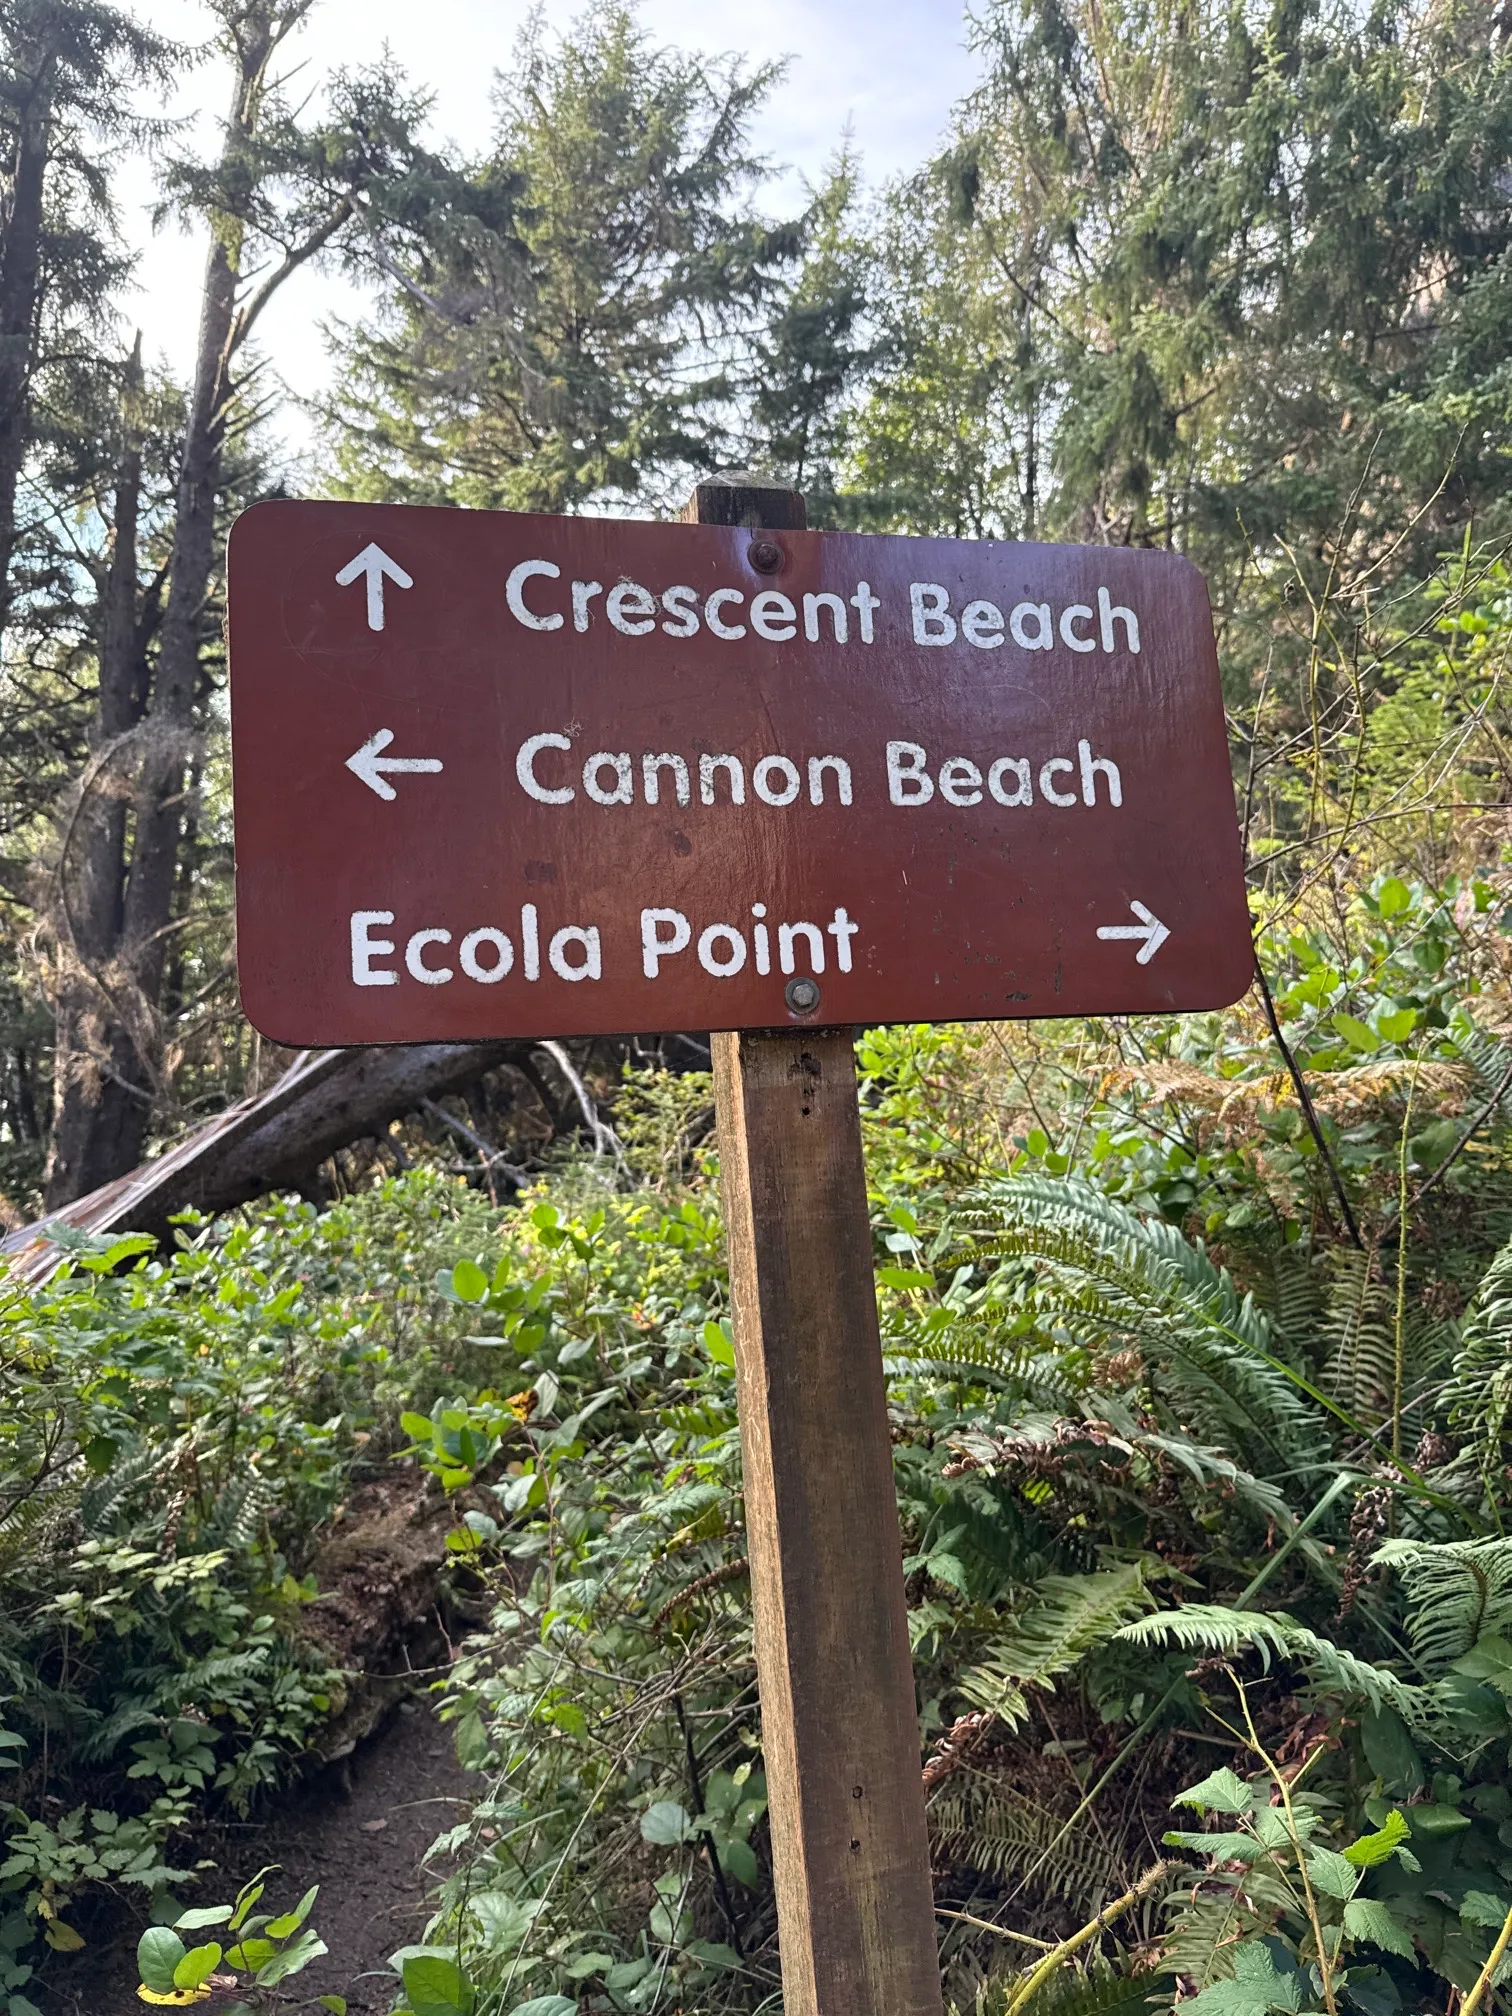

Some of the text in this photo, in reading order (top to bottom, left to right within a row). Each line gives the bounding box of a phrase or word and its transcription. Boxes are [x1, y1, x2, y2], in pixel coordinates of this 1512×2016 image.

[505, 559, 1141, 654] Crescent Beach
[515, 732, 1123, 808] Cannon Beach
[350, 902, 859, 987] Ecola Point
